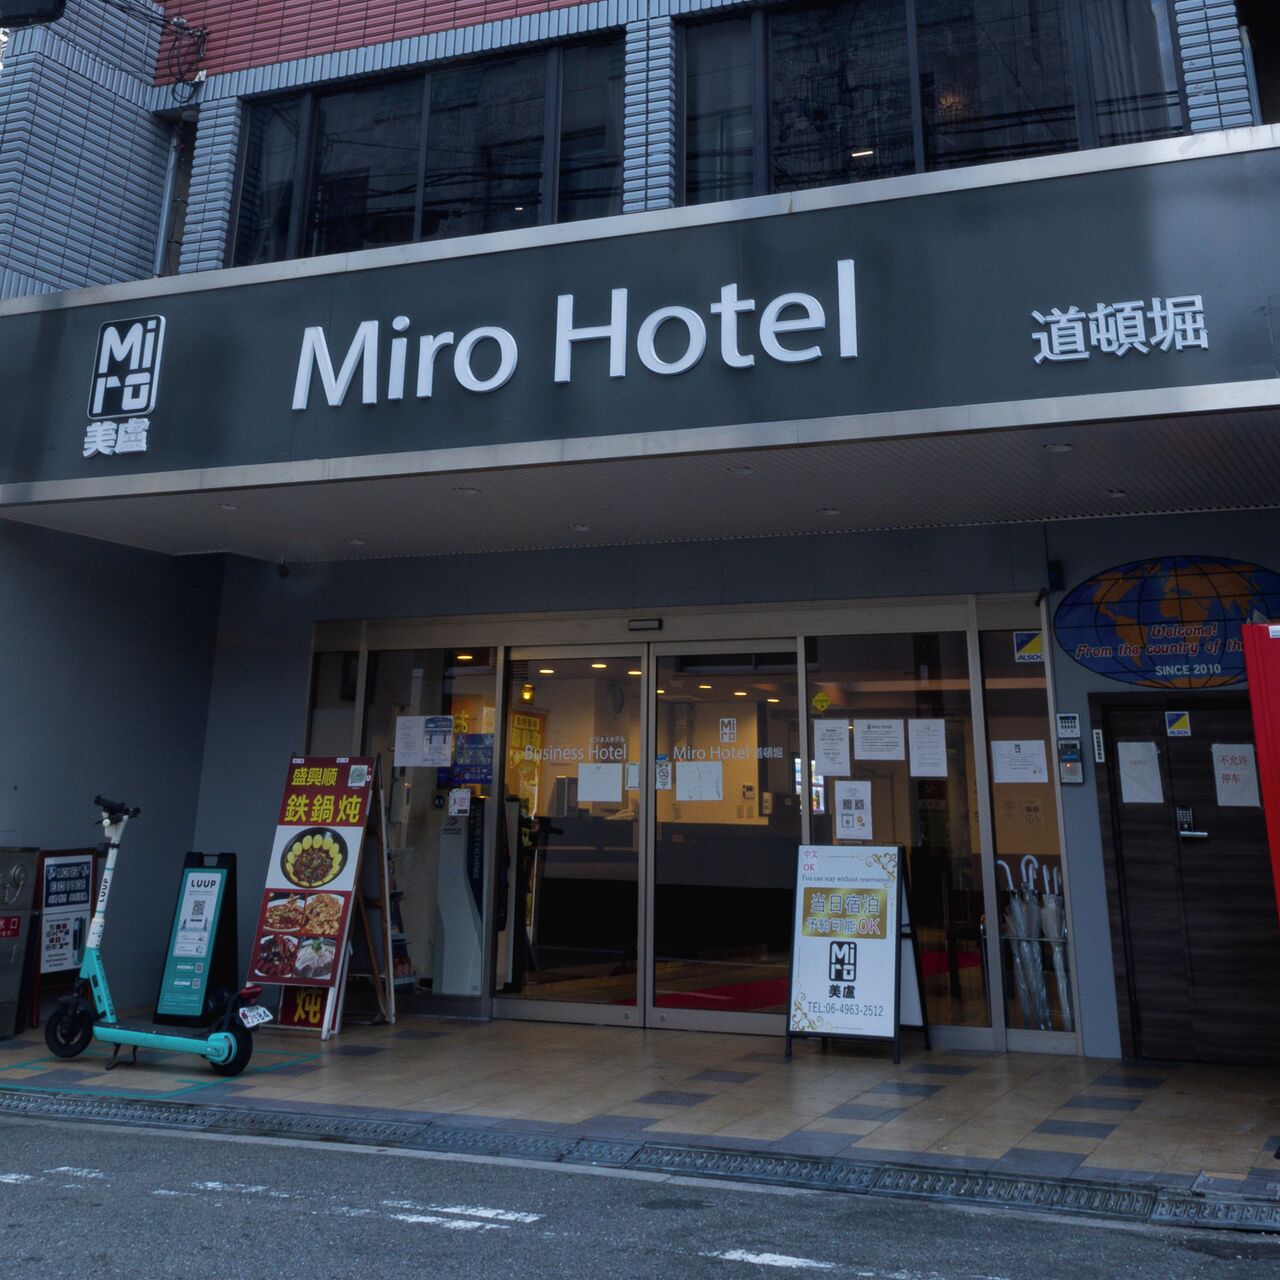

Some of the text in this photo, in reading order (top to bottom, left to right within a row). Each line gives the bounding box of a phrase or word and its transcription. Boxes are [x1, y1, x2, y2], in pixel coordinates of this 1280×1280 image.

[292, 258, 858, 410] Miro Hotel
[1031, 294, 1209, 364] 道頓堀
[1151, 623, 1217, 638] Welcome!
[1076, 644, 1112, 659] From
[1119, 643, 1140, 656] the
[1146, 642, 1198, 657] country
[1205, 640, 1221, 654] of
[1155, 664, 1221, 676] SINCE 2010
[524, 745, 584, 761] Business
[588, 744, 627, 760] Hotel
[673, 745, 706, 760] Miro
[710, 744, 749, 760] Hotel
[803, 863, 815, 871] OK
[99, 878, 110, 903] LUUP
[191, 880, 216, 888] LUUP
[810, 892, 880, 915] 当日宿泊
[807, 1001, 884, 1017] TEL:06-4963-2512
